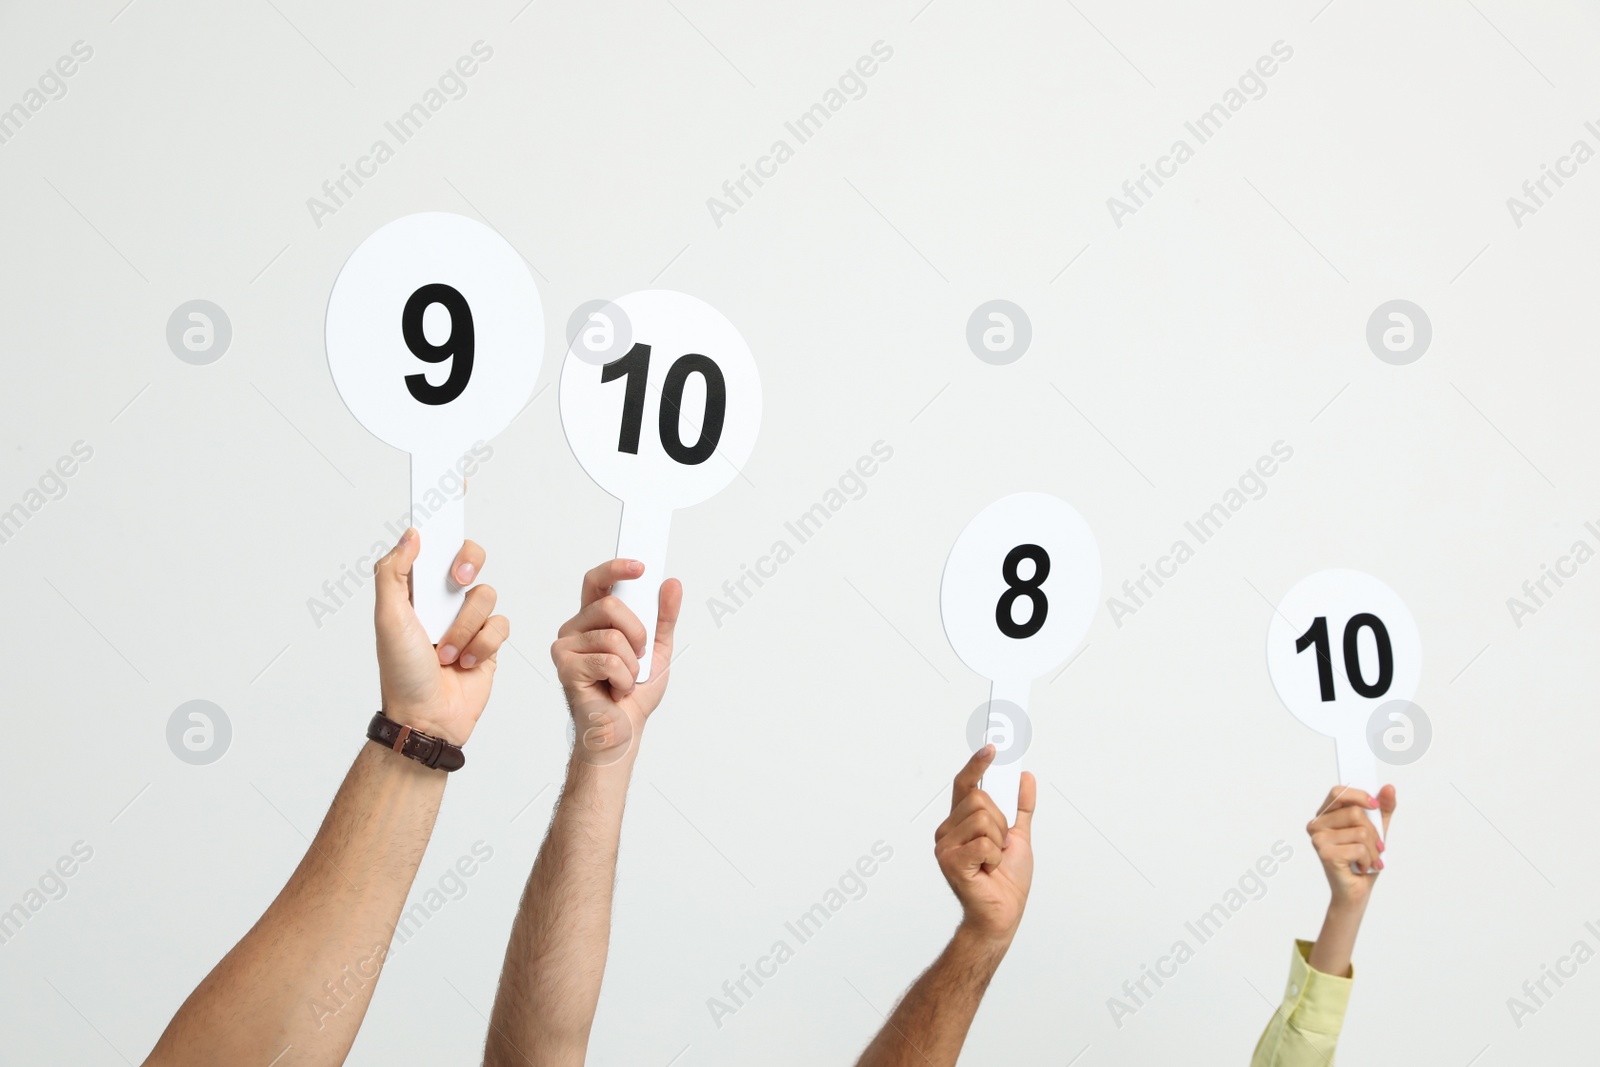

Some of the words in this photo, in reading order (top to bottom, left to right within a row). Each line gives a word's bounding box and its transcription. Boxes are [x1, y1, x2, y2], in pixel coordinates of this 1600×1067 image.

[402, 283, 475, 406] 9
[601, 342, 726, 466] 10
[995, 543, 1051, 639] 8
[1295, 612, 1394, 703] 10
